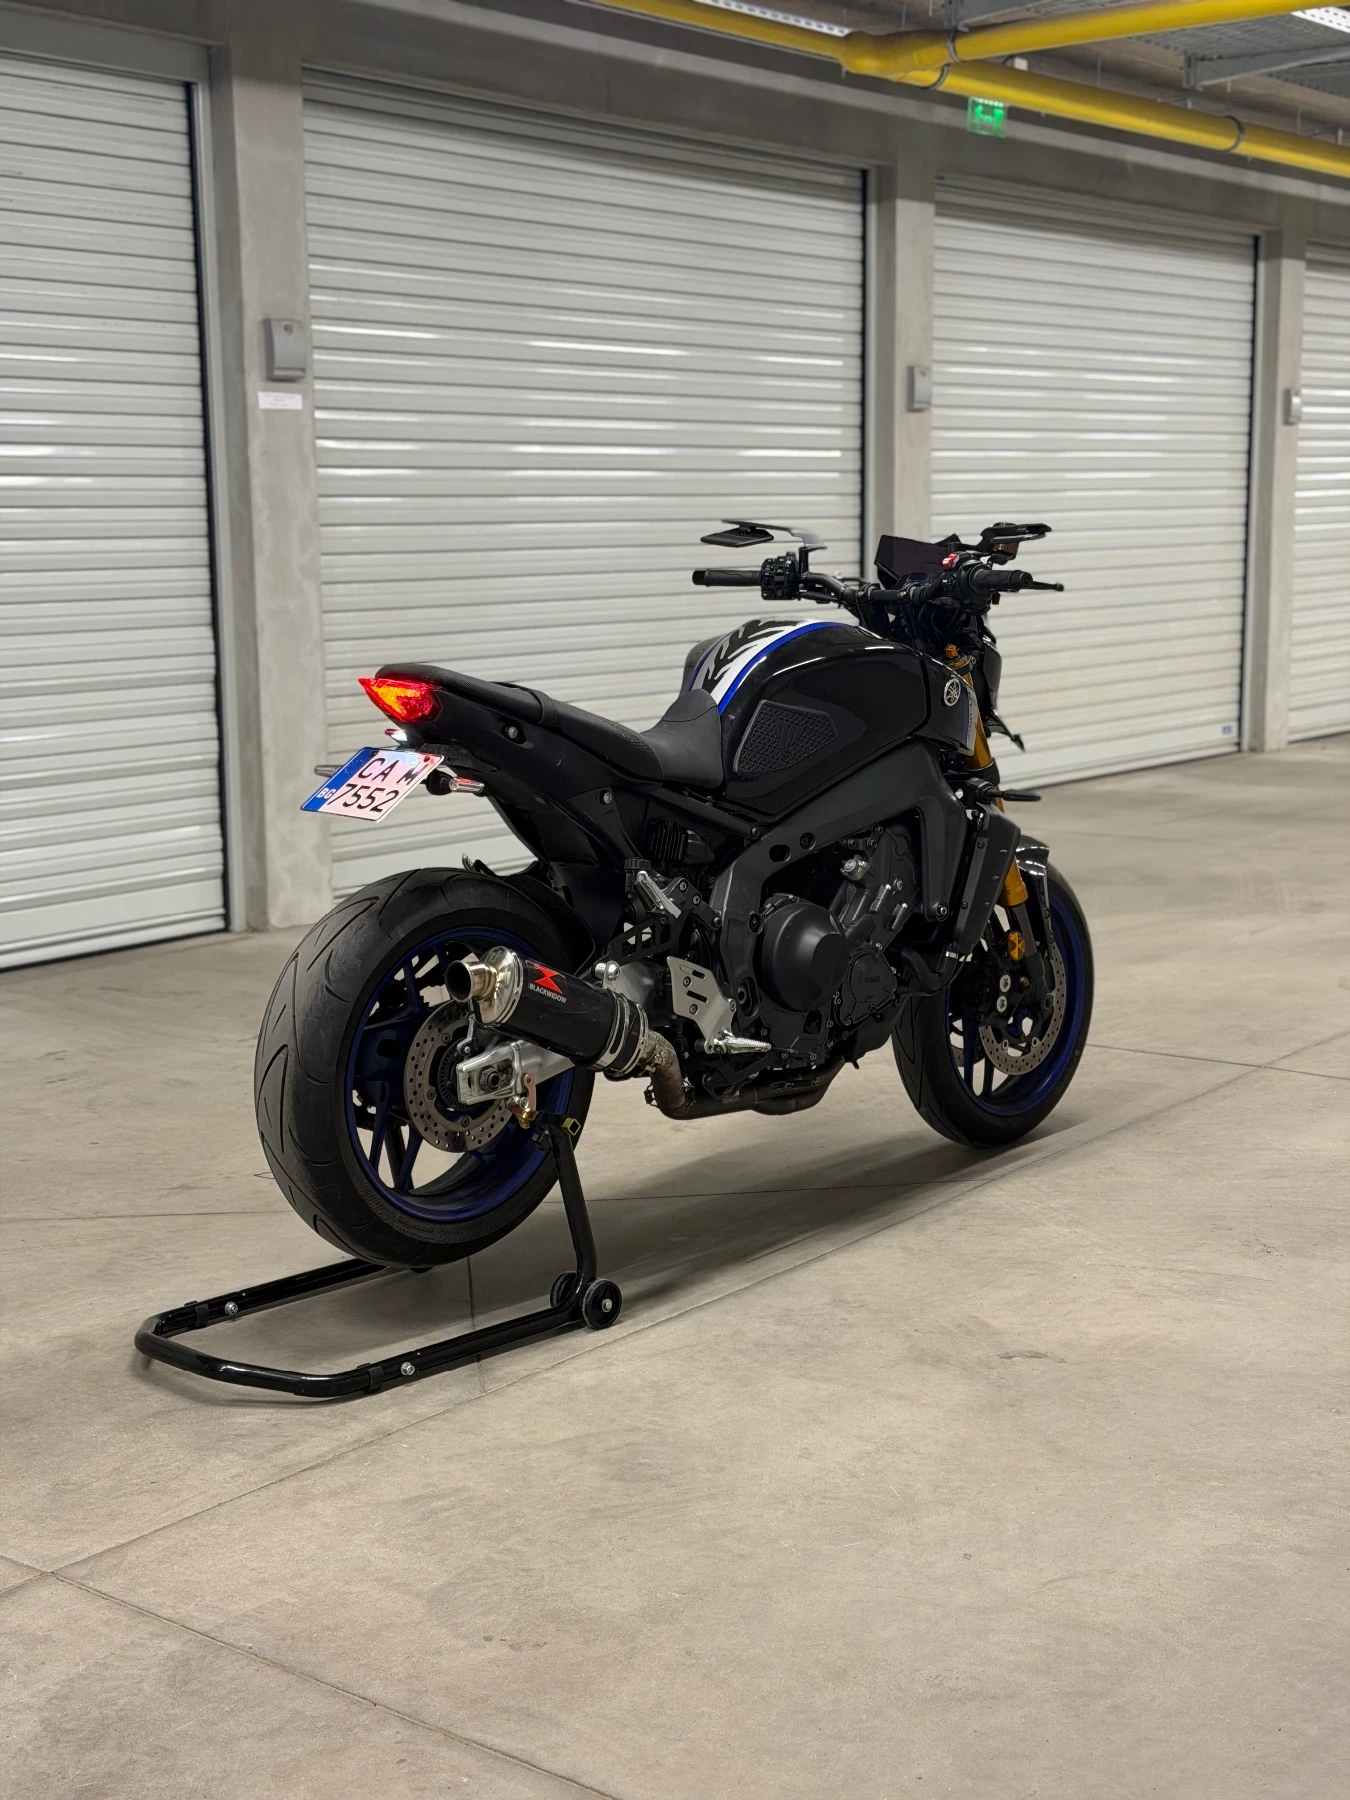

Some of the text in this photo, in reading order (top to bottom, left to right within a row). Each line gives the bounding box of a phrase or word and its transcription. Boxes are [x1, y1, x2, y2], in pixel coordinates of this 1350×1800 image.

[358, 758, 400, 782] CA
[316, 787, 337, 799] BG
[327, 783, 400, 812] 7552
[529, 983, 567, 1004] BLACKWIDOW
